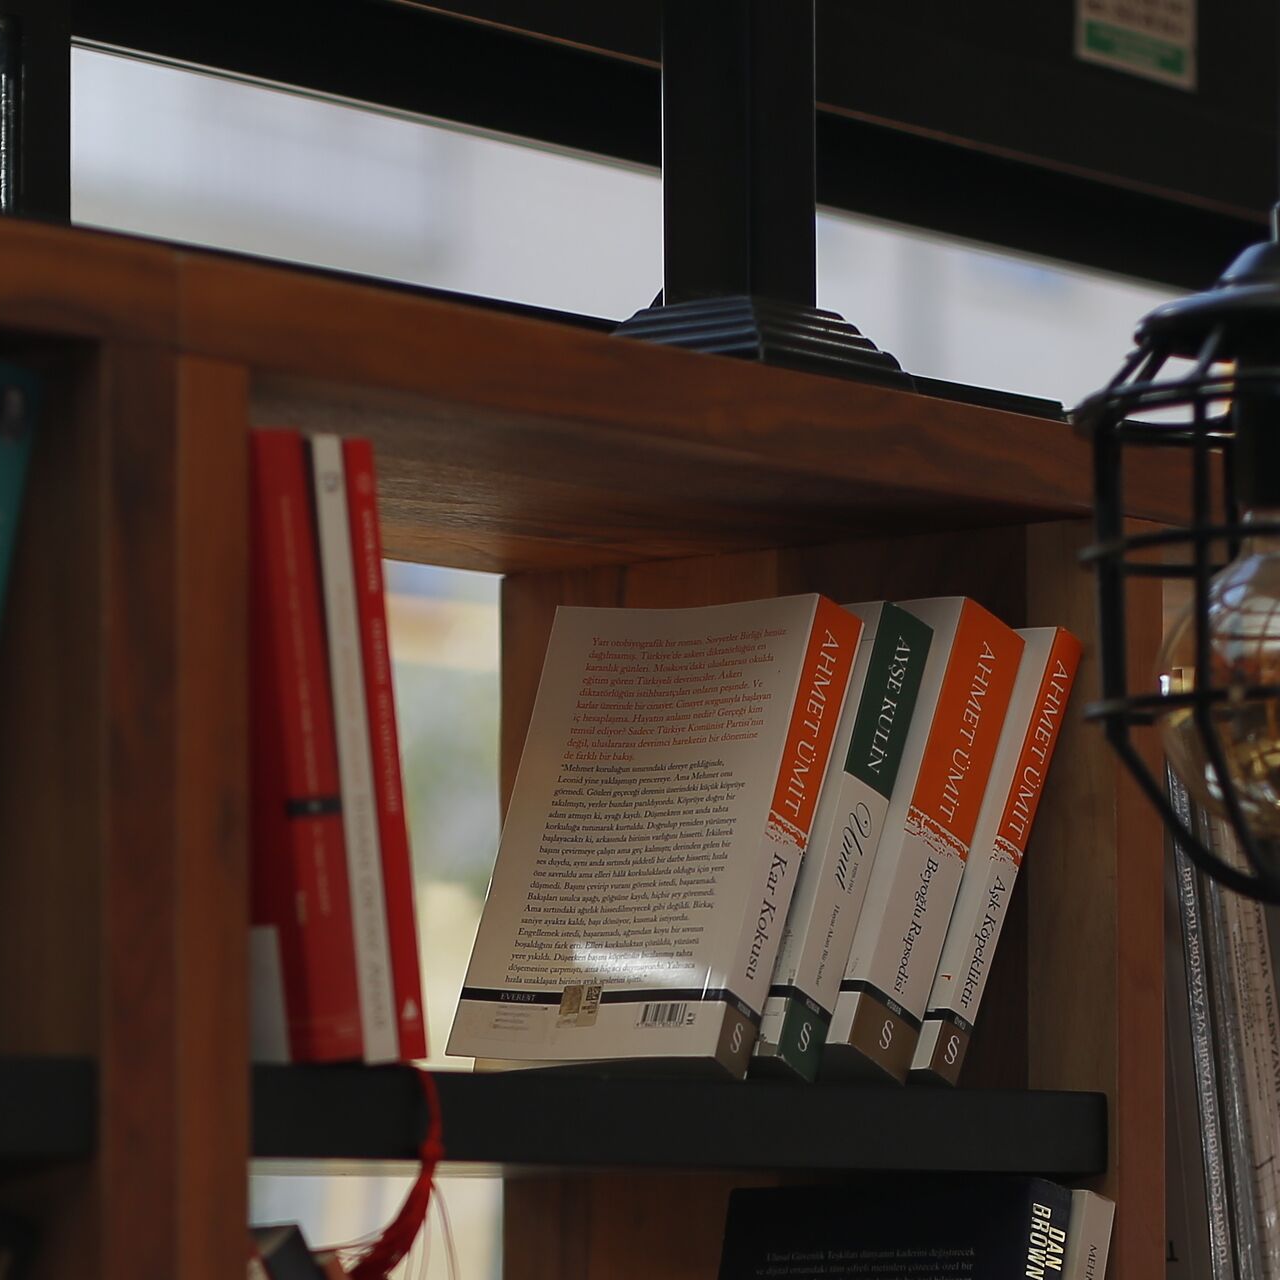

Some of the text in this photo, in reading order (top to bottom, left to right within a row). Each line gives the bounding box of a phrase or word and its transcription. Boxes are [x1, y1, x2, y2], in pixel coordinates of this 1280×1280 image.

[599, 752, 611, 760] bir
[784, 629, 840, 818] AHMET ÜMİT
[867, 636, 911, 775] AYŞE KULİN
[939, 641, 997, 823] AHMET ÜMİT
[1009, 660, 1069, 842] AHMET ÜMİT
[745, 852, 788, 981] Kar Kokusu
[894, 856, 939, 996] Beyoğlu Rapsodisi
[961, 875, 1007, 1009] Aşk Köpekliktir
[1045, 1226, 1066, 1271] DAN
